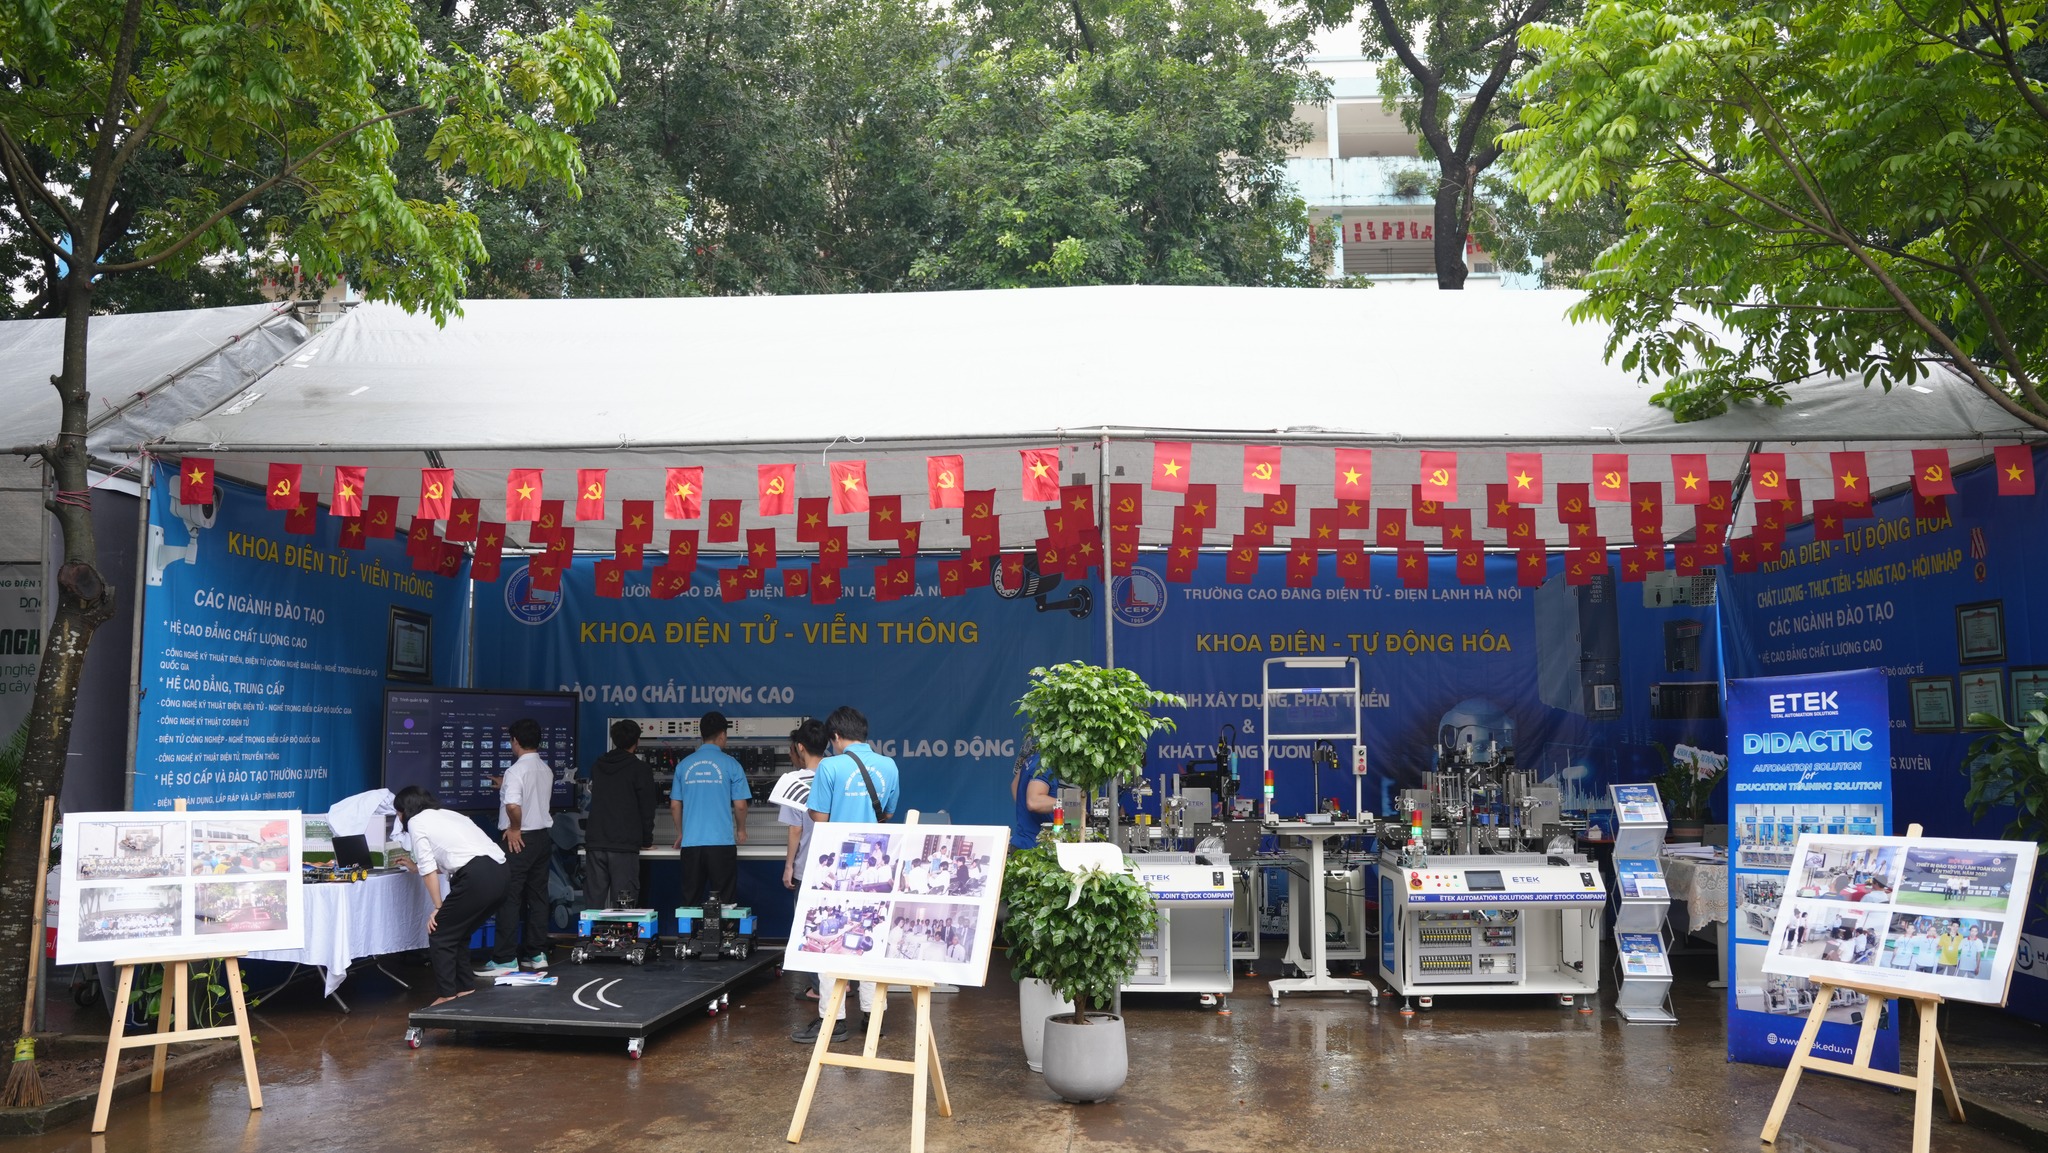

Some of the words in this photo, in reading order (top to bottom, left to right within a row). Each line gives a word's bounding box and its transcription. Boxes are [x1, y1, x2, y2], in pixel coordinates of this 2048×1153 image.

[1844, 527, 1862, 556] TỰ
[1866, 517, 1910, 550] ĐỘNG
[228, 530, 279, 564] KHOA
[285, 544, 324, 574] ĐIỆN
[328, 550, 348, 578] TỬ
[360, 558, 390, 588] VIỄN
[393, 572, 433, 599] THÔNG
[1856, 566, 1884, 589] SÁNG
[1884, 562, 1906, 585] TẠO
[1912, 553, 1930, 579] HỘI
[1931, 547, 1962, 574] NHẬP
[14, 578, 36, 589] ĐIỆN
[1184, 586, 1243, 600] TRƯỜNG
[1248, 588, 1278, 600] CAO
[1364, 585, 1382, 600] TỬ
[1432, 589, 1470, 602] LẠNH
[1474, 586, 1494, 600] HÀ
[1498, 586, 1522, 602] NỘI
[194, 588, 225, 609] CÁC
[228, 594, 272, 616] NGÀNH
[275, 600, 300, 620] ĐÀO
[304, 607, 325, 626] TẠO
[1769, 616, 1791, 637] CÁC
[1793, 610, 1834, 633] NGÀNH
[1837, 604, 1863, 627] ĐÀO
[1866, 601, 1894, 624] TẠO
[170, 620, 182, 636] HỆ
[184, 624, 203, 637] CAO
[205, 620, 231, 640] ĐẲNG
[233, 628, 257, 643] CHẤT
[260, 632, 290, 647] LƯỢNG
[292, 637, 308, 648] CAO
[580, 622, 656, 644] KHOA
[666, 616, 730, 648] ĐIỆN
[740, 614, 778, 644] TỬ
[802, 612, 868, 644] VIỄN
[877, 616, 978, 644] THÔNG
[1196, 634, 1262, 652] KHOA
[1270, 630, 1325, 656] ĐIỆN
[1348, 631, 1380, 656] TỰ
[1385, 630, 1454, 656] ĐỘNG
[1462, 629, 1512, 652] HÓA
[166, 648, 183, 657] CÔNG
[209, 653, 228, 663] THUẬT
[1771, 652, 1785, 663] CAO
[1786, 643, 1807, 661] ĐẲNG
[1809, 641, 1830, 658] CHẤT
[1832, 641, 1861, 658] LƯỢNG
[1863, 639, 1882, 652] CAO
[5, 664, 36, 677] nghệ
[160, 659, 180, 670] QUỐC
[1898, 663, 1914, 676] QUỐC
[9, 680, 30, 694] cây
[166, 675, 181, 691] HỆ
[184, 678, 200, 690] CAO
[203, 674, 232, 694] ĐẲNG,
[234, 682, 263, 694] TRUNG
[266, 681, 284, 695] CẤP
[602, 685, 637, 706] TẠO
[642, 678, 686, 704] CHẤT
[692, 686, 752, 706] LƯỢNG
[758, 686, 794, 704] CAO
[161, 698, 180, 707] CÔNG
[182, 699, 198, 709] NGHỆ
[199, 700, 206, 708] KỸ
[208, 701, 226, 710] THUẬT
[1205, 691, 1238, 707] XÂY
[1769, 690, 1838, 713] ETEK
[161, 715, 178, 725] CÔNG
[180, 716, 195, 726] NGHỆ
[205, 716, 220, 727] THUẬT
[1242, 718, 1255, 734] &
[159, 734, 174, 744] ĐIỆN
[175, 733, 185, 743] TỬ
[186, 735, 203, 743] CÔNG
[1743, 728, 1873, 754] DIDACTIC
[903, 739, 948, 757] LAO
[954, 736, 1014, 760] ĐỘNG
[159, 753, 174, 762] CÔNG
[176, 753, 193, 763] NGHỆ
[204, 752, 219, 762] THUẬT
[1899, 754, 1931, 770] XUYÊN
[1752, 763, 1813, 773] AUTOMATION
[1814, 762, 1862, 771] SOLUTION
[161, 770, 174, 788] HỆ
[176, 772, 191, 785] SƠ
[193, 768, 213, 783] CẤP
[215, 769, 226, 783] VÀ
[228, 769, 248, 783] ĐÀO
[250, 770, 268, 783] TẠO
[270, 767, 302, 780] THƯỜNG
[304, 766, 328, 779] XUYÊN
[1798, 769, 1819, 784] for
[1735, 783, 1787, 792] EDUCATION
[1789, 782, 1832, 791] TRAINING
[1833, 781, 1882, 791] SOLUTION
[158, 797, 172, 808] ĐIỆN
[241, 792, 249, 801] VÀ
